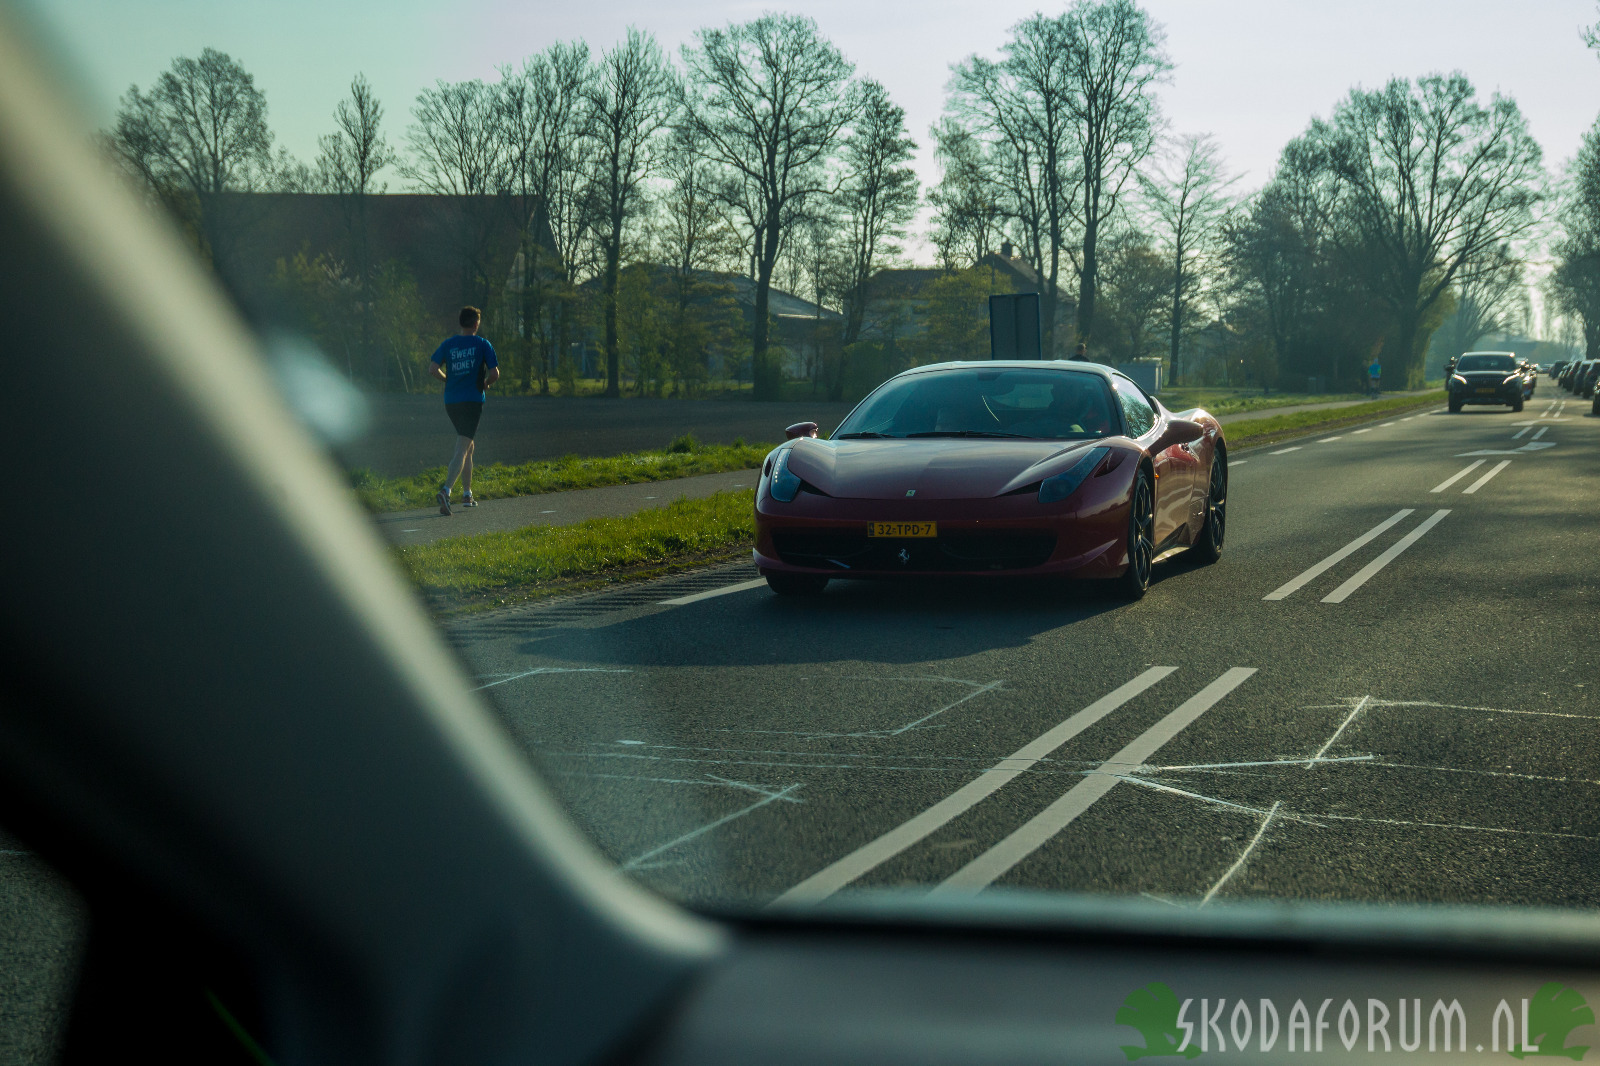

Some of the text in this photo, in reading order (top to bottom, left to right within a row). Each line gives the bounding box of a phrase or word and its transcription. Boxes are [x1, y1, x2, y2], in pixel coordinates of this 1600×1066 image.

[451, 347, 476, 360] SWEAT
[451, 359, 476, 372] MONEY
[878, 524, 932, 535] 32-TPD-7
